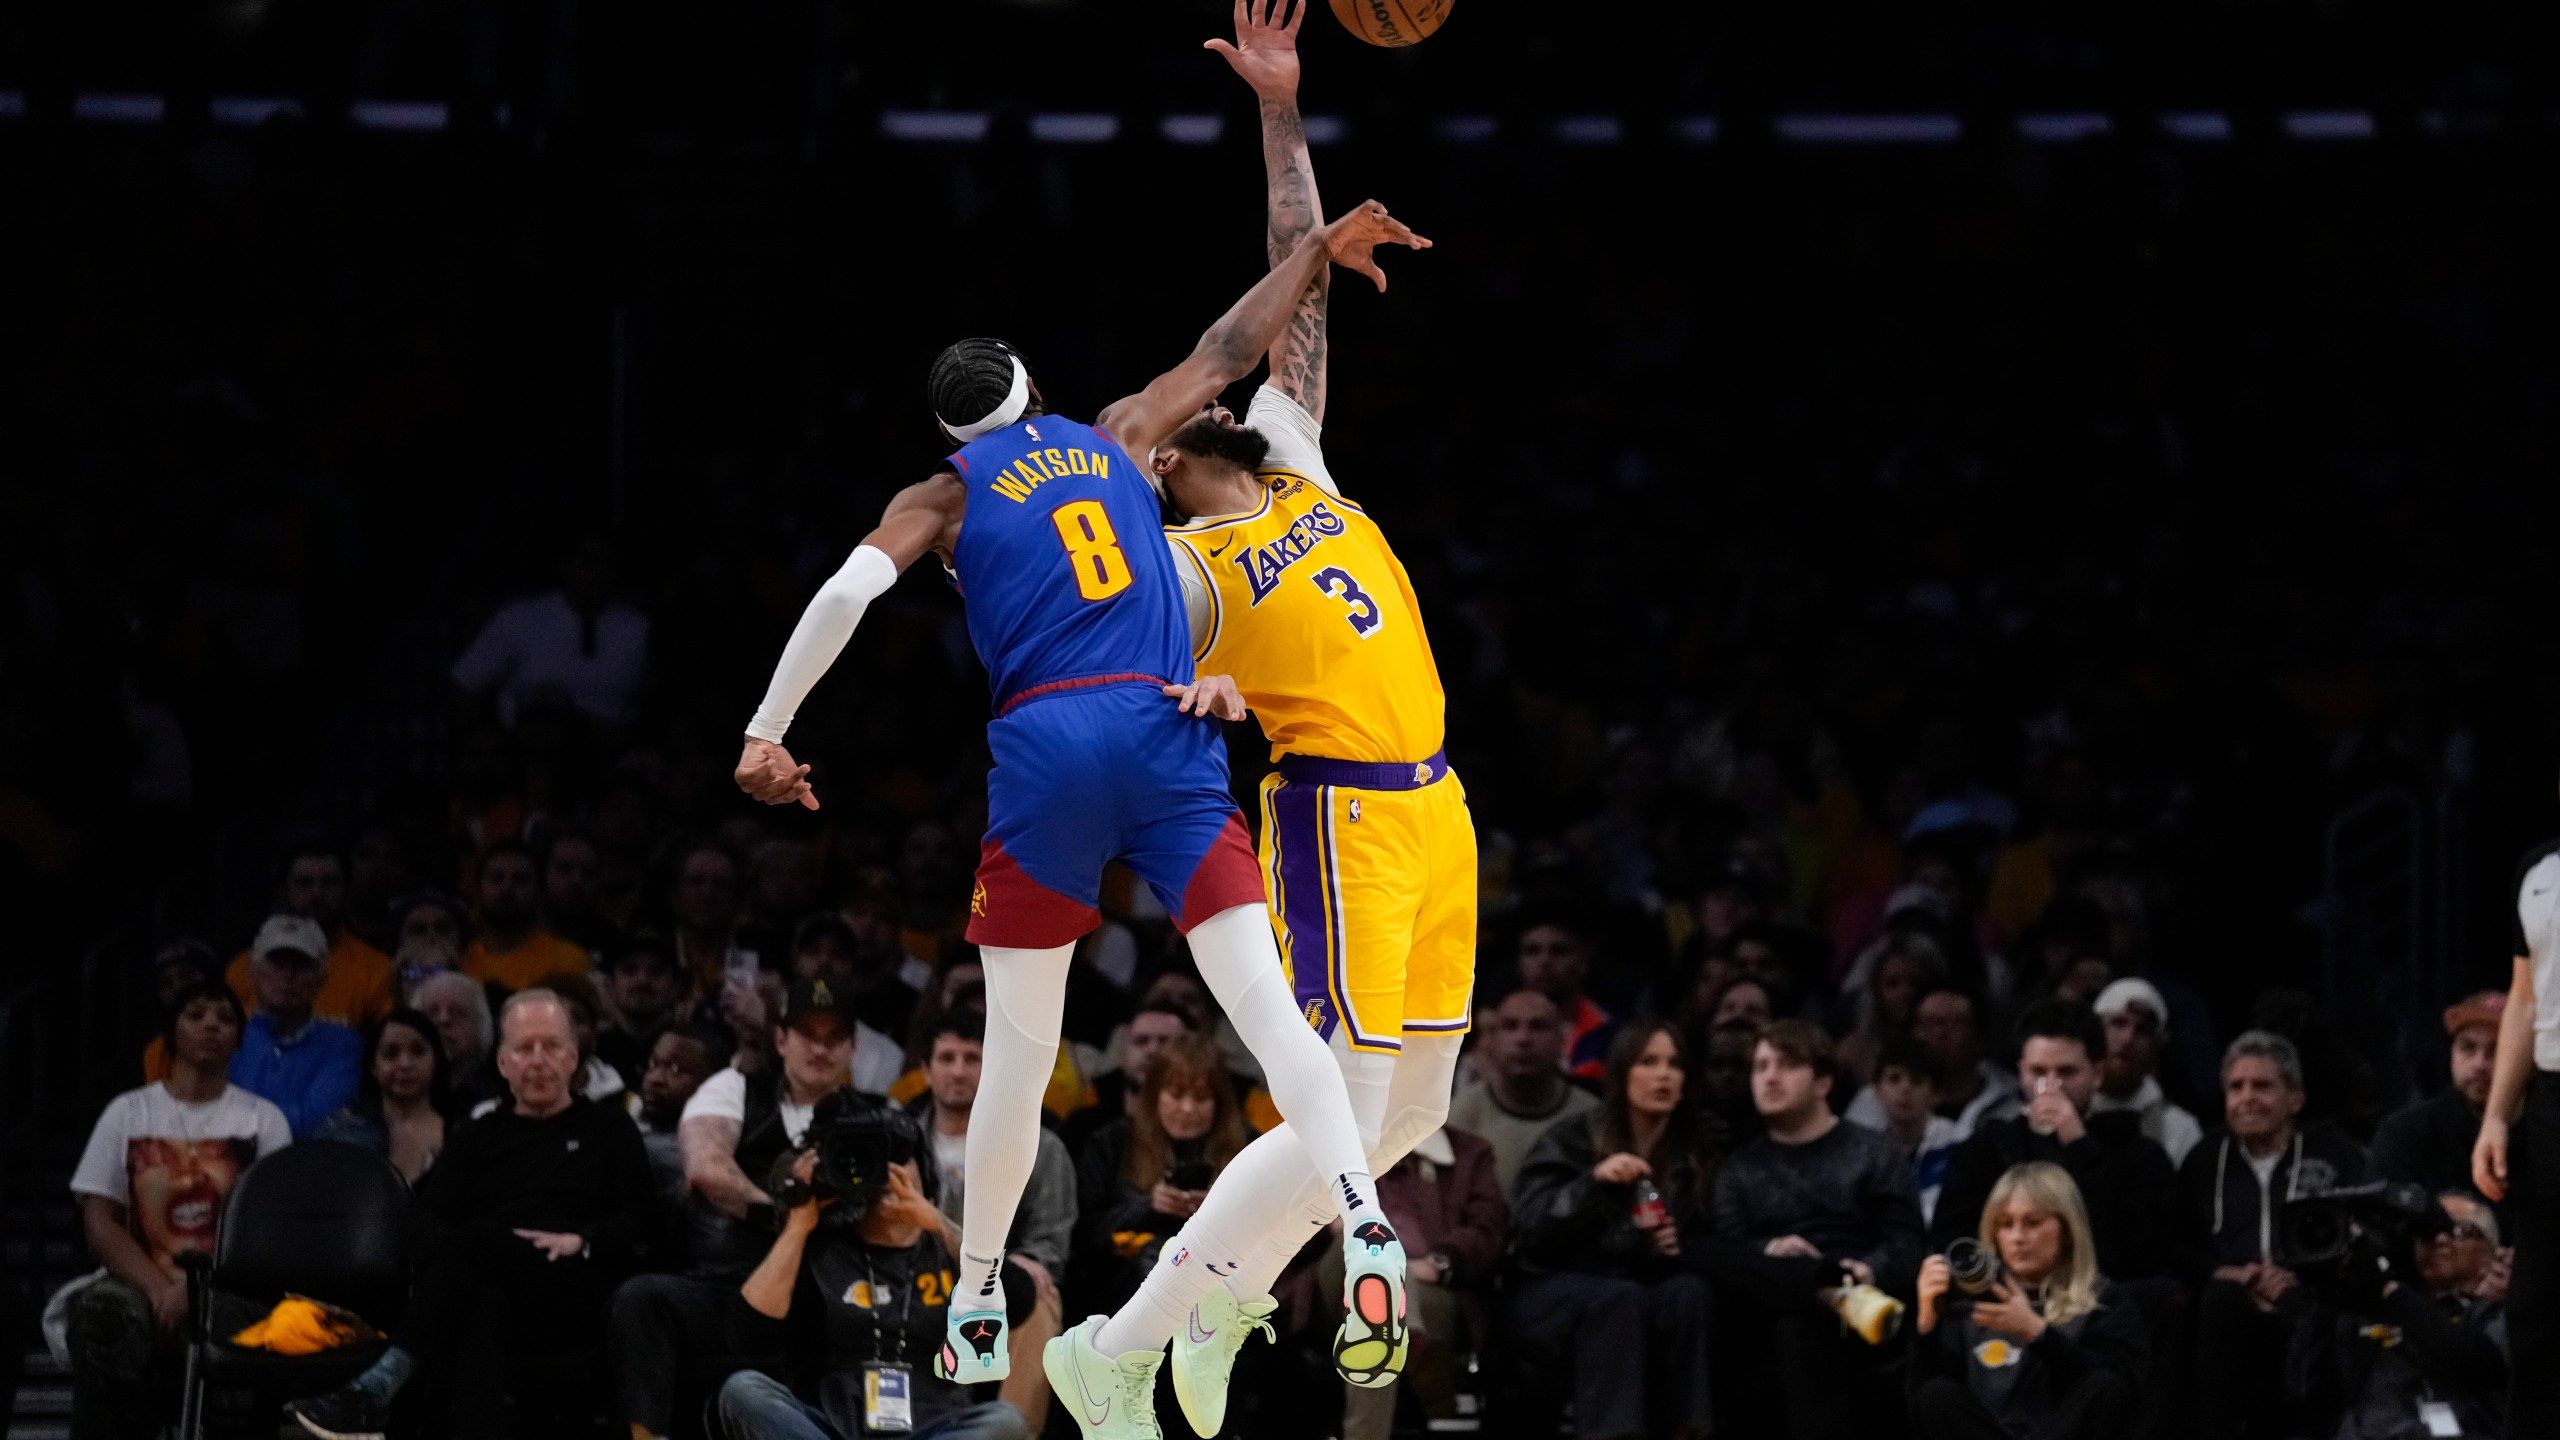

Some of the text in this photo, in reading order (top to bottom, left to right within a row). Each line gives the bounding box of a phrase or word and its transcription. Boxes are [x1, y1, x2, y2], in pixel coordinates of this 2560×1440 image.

[990, 448, 1109, 504] WATSON
[1278, 480, 1304, 500] bibigo
[1049, 498, 1135, 603] 8
[1233, 502, 1345, 609] LAKERS
[1311, 565, 1383, 641] 3
